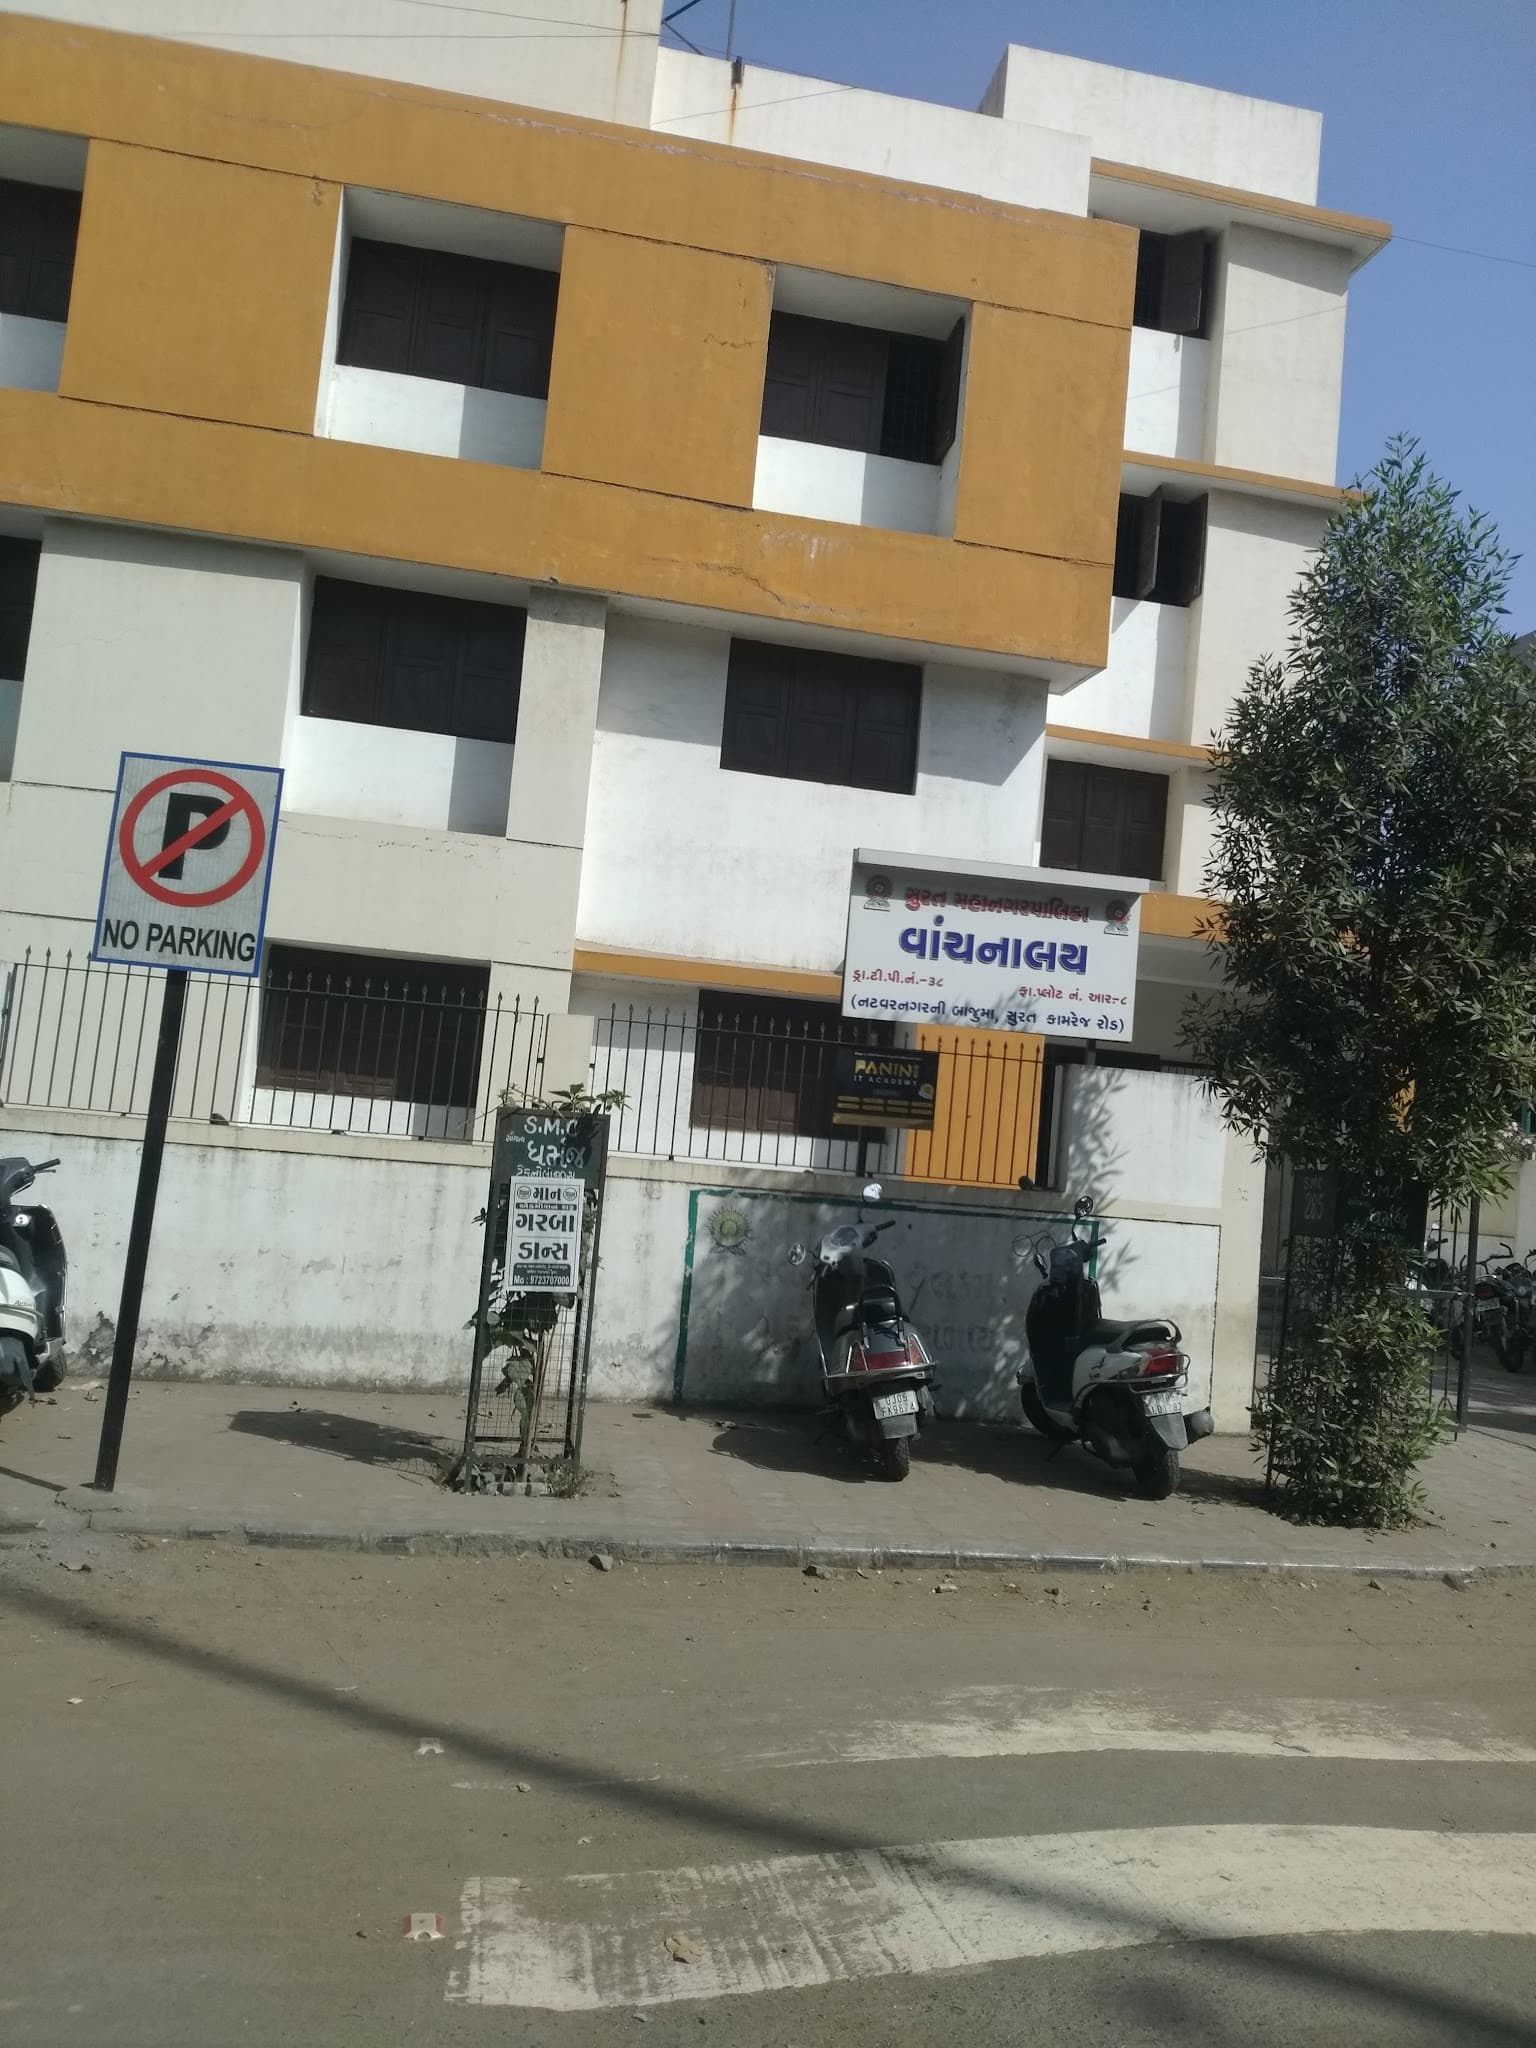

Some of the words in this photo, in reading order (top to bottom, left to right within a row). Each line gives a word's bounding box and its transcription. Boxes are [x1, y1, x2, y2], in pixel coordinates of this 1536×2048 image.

[905, 886, 946, 910] સુરત
[953, 891, 1089, 922] મહાનગરપાલિકા
[102, 918, 139, 950] NO
[145, 922, 256, 961] PARKING
[899, 914, 1089, 975] વાંચનાલય
[1006, 1010, 1037, 1026] સુરત
[1046, 1011, 1091, 1028] કામરેજ
[1096, 1014, 1125, 1033] રોડ)
[515, 1212, 575, 1233] ગરબા
[518, 1241, 568, 1261] ડાન્સ
